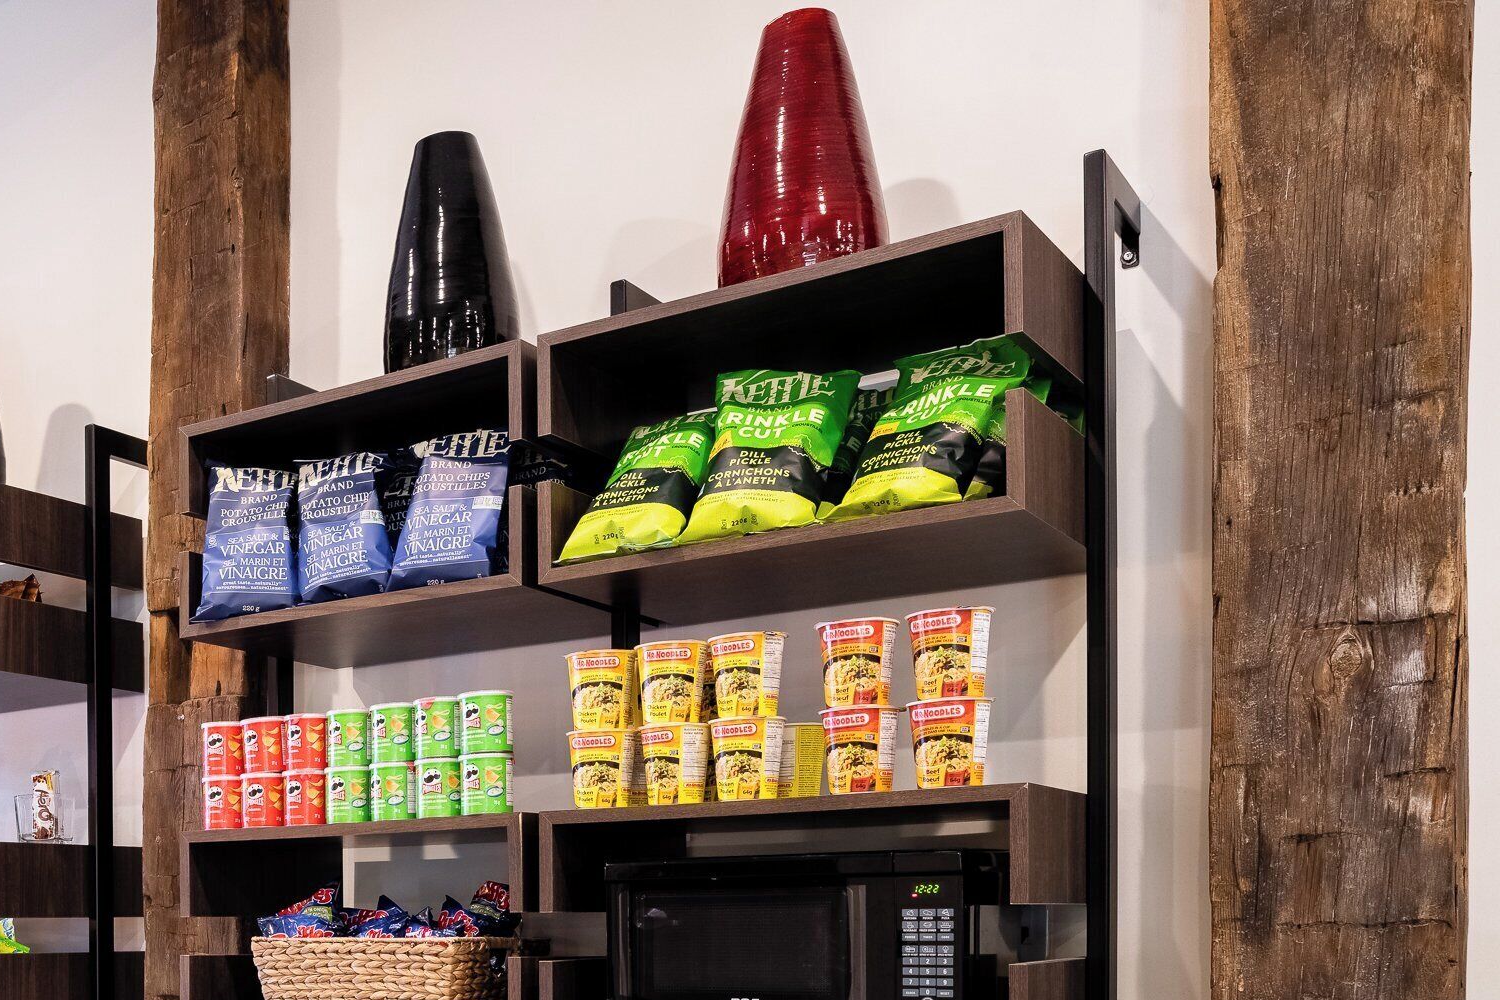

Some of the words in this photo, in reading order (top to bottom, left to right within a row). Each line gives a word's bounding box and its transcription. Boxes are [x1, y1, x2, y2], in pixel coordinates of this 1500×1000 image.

[718, 371, 836, 405] KETTLE
[922, 375, 965, 393] BRAND
[882, 384, 997, 418] KRINKLE
[748, 405, 793, 414] BRAND
[906, 401, 952, 424] CUT
[738, 427, 787, 439] CUT
[896, 430, 921, 440] DILL
[884, 435, 924, 450] PICKLE
[740, 451, 767, 459] DILL
[861, 444, 938, 468] CORNICHONS
[430, 461, 472, 469] BRAND
[729, 457, 772, 466] PICKLE
[874, 454, 922, 469] L'ANETH
[456, 472, 491, 481] CHIPS
[620, 472, 643, 480] DILL
[708, 468, 790, 483] CORNICHONS
[317, 480, 354, 494] BRAND
[726, 477, 777, 487] L'ANETH
[241, 494, 277, 505] BRAND
[592, 485, 660, 502] ORNICHONS
[301, 496, 341, 513] POTATO
[603, 494, 646, 506] L'ANETH
[220, 507, 263, 519] POTATO
[414, 505, 430, 515] SEA
[432, 504, 458, 513] SALT
[407, 512, 472, 531] VINEGAR
[307, 529, 322, 540] SEA
[324, 523, 346, 534] SALT
[406, 533, 422, 543] SEL
[424, 528, 455, 539] MARIN
[457, 526, 470, 534] ET
[228, 537, 244, 545] SEA
[246, 533, 269, 543] SALT
[270, 533, 279, 541] &
[303, 526, 364, 555] VINEGAR
[220, 542, 285, 557] VINEGAR
[404, 535, 472, 557] VINAIGRE
[307, 555, 319, 566] SEL
[320, 544, 350, 560] MARIN
[351, 541, 365, 550] ET
[223, 559, 237, 568] SEL
[240, 558, 271, 567] MARIN
[272, 558, 285, 566] ET
[304, 549, 369, 579] VINAIGRE
[219, 567, 288, 580] VINAIGRE
[922, 617, 957, 628] NOODLES
[835, 627, 871, 638] NOODLES
[720, 643, 751, 652] NOODLES
[656, 650, 688, 659] NOODLES
[586, 658, 617, 667] NOODLES
[923, 707, 961, 718] NOODLES
[832, 716, 865, 726] NOODLES
[722, 726, 752, 735] NOODLES
[582, 737, 612, 746] NOODLES
[35, 789, 53, 821] Aero
[915, 885, 940, 893] 12:22
